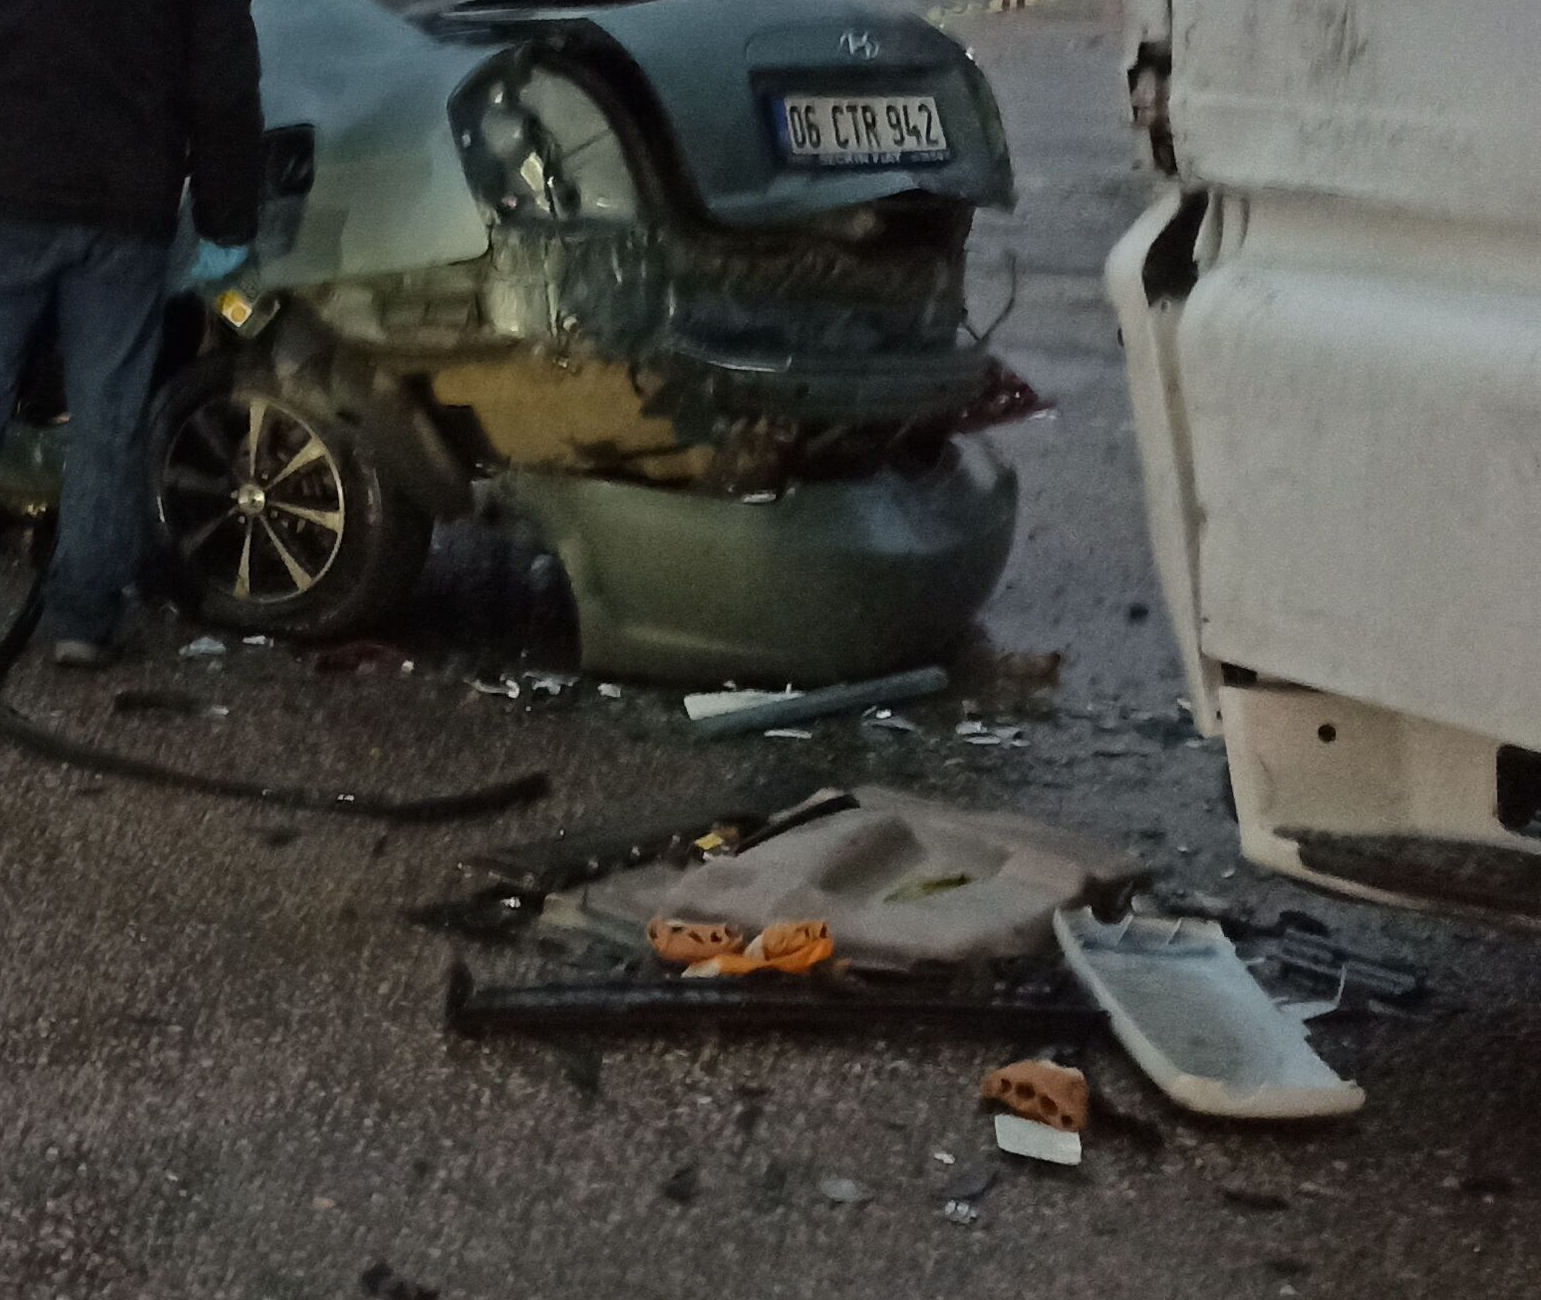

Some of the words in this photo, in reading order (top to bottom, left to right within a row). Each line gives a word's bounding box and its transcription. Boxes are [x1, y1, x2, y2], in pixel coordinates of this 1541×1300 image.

[789, 104, 821, 149] 06
[832, 104, 880, 149] CTR
[886, 103, 939, 147] 942
